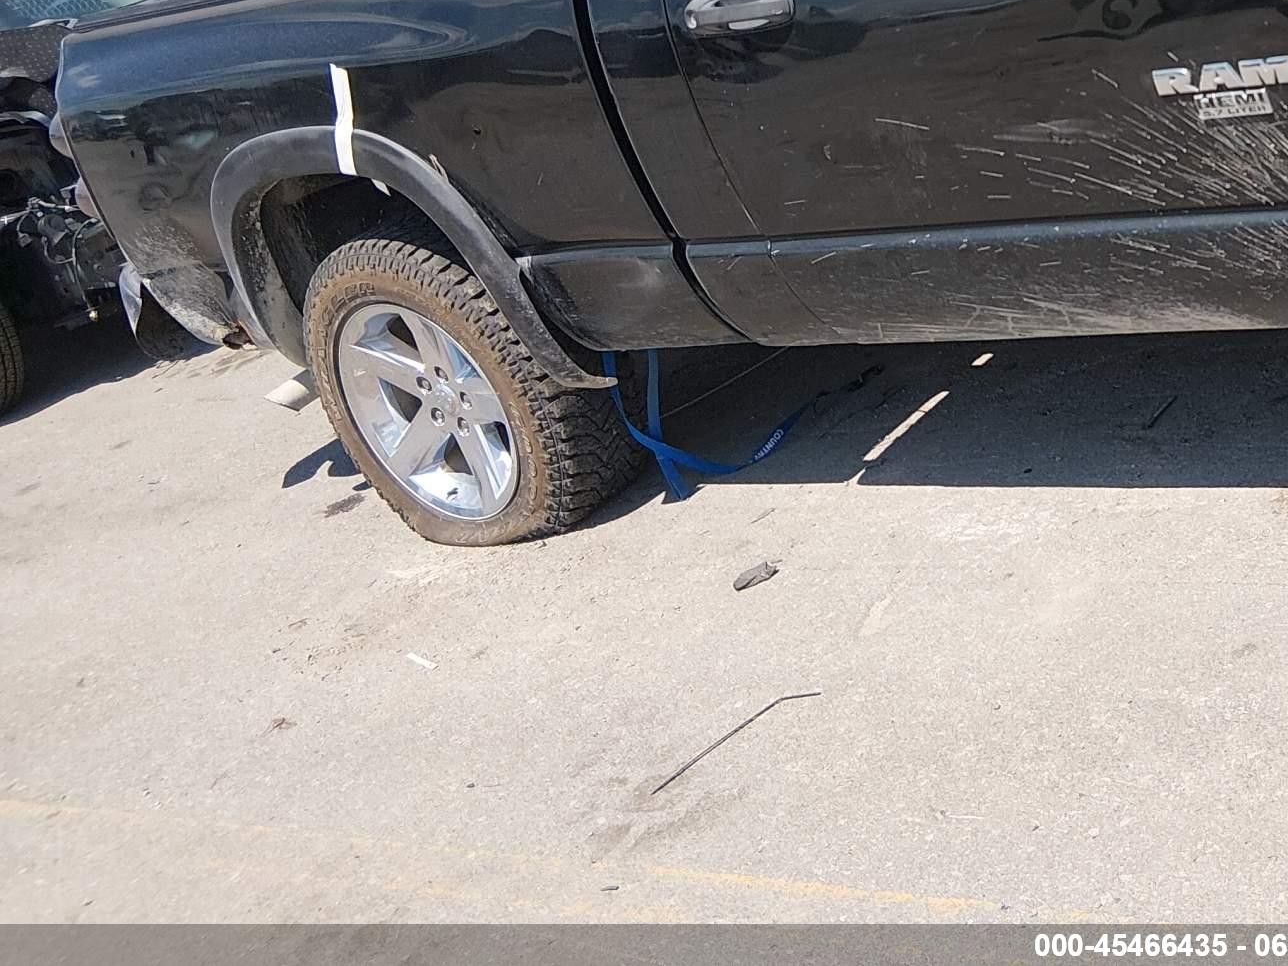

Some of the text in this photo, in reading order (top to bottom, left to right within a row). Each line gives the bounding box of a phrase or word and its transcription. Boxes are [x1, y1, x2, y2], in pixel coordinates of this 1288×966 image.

[1197, 91, 1266, 108] HEMI
[1228, 105, 1268, 115] LITER
[754, 429, 784, 461] COUNTRY
